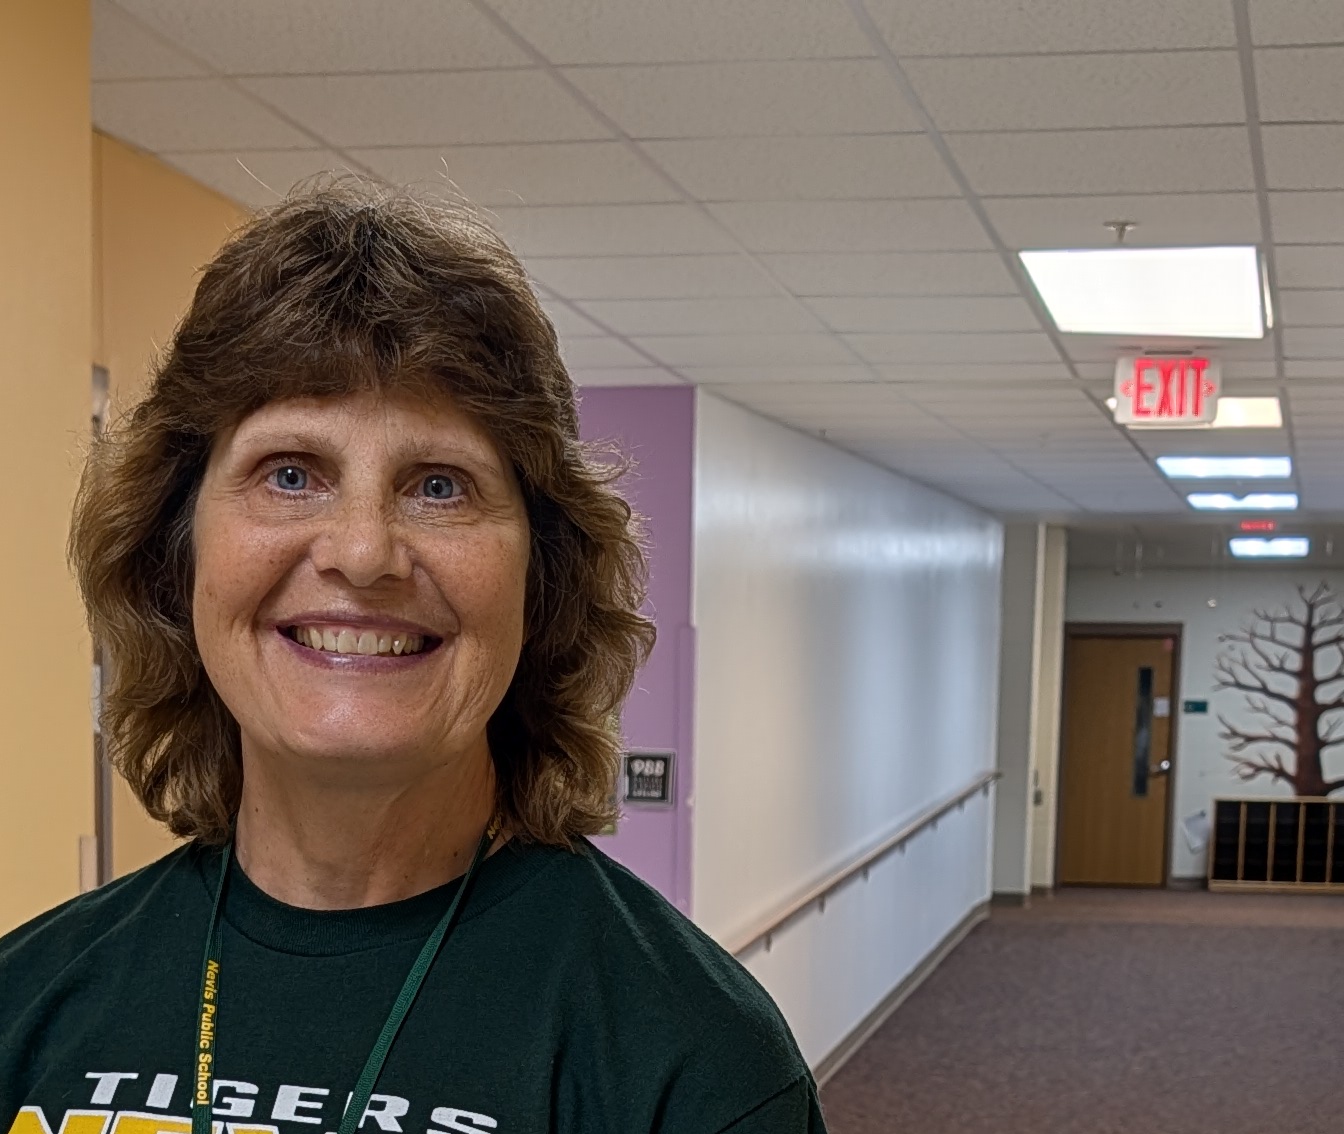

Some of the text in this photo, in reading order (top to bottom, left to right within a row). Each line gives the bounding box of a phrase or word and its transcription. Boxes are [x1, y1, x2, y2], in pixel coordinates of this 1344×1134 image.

[1132, 357, 1210, 417] EXIT
[196, 959, 219, 1105] Nevis Public School
